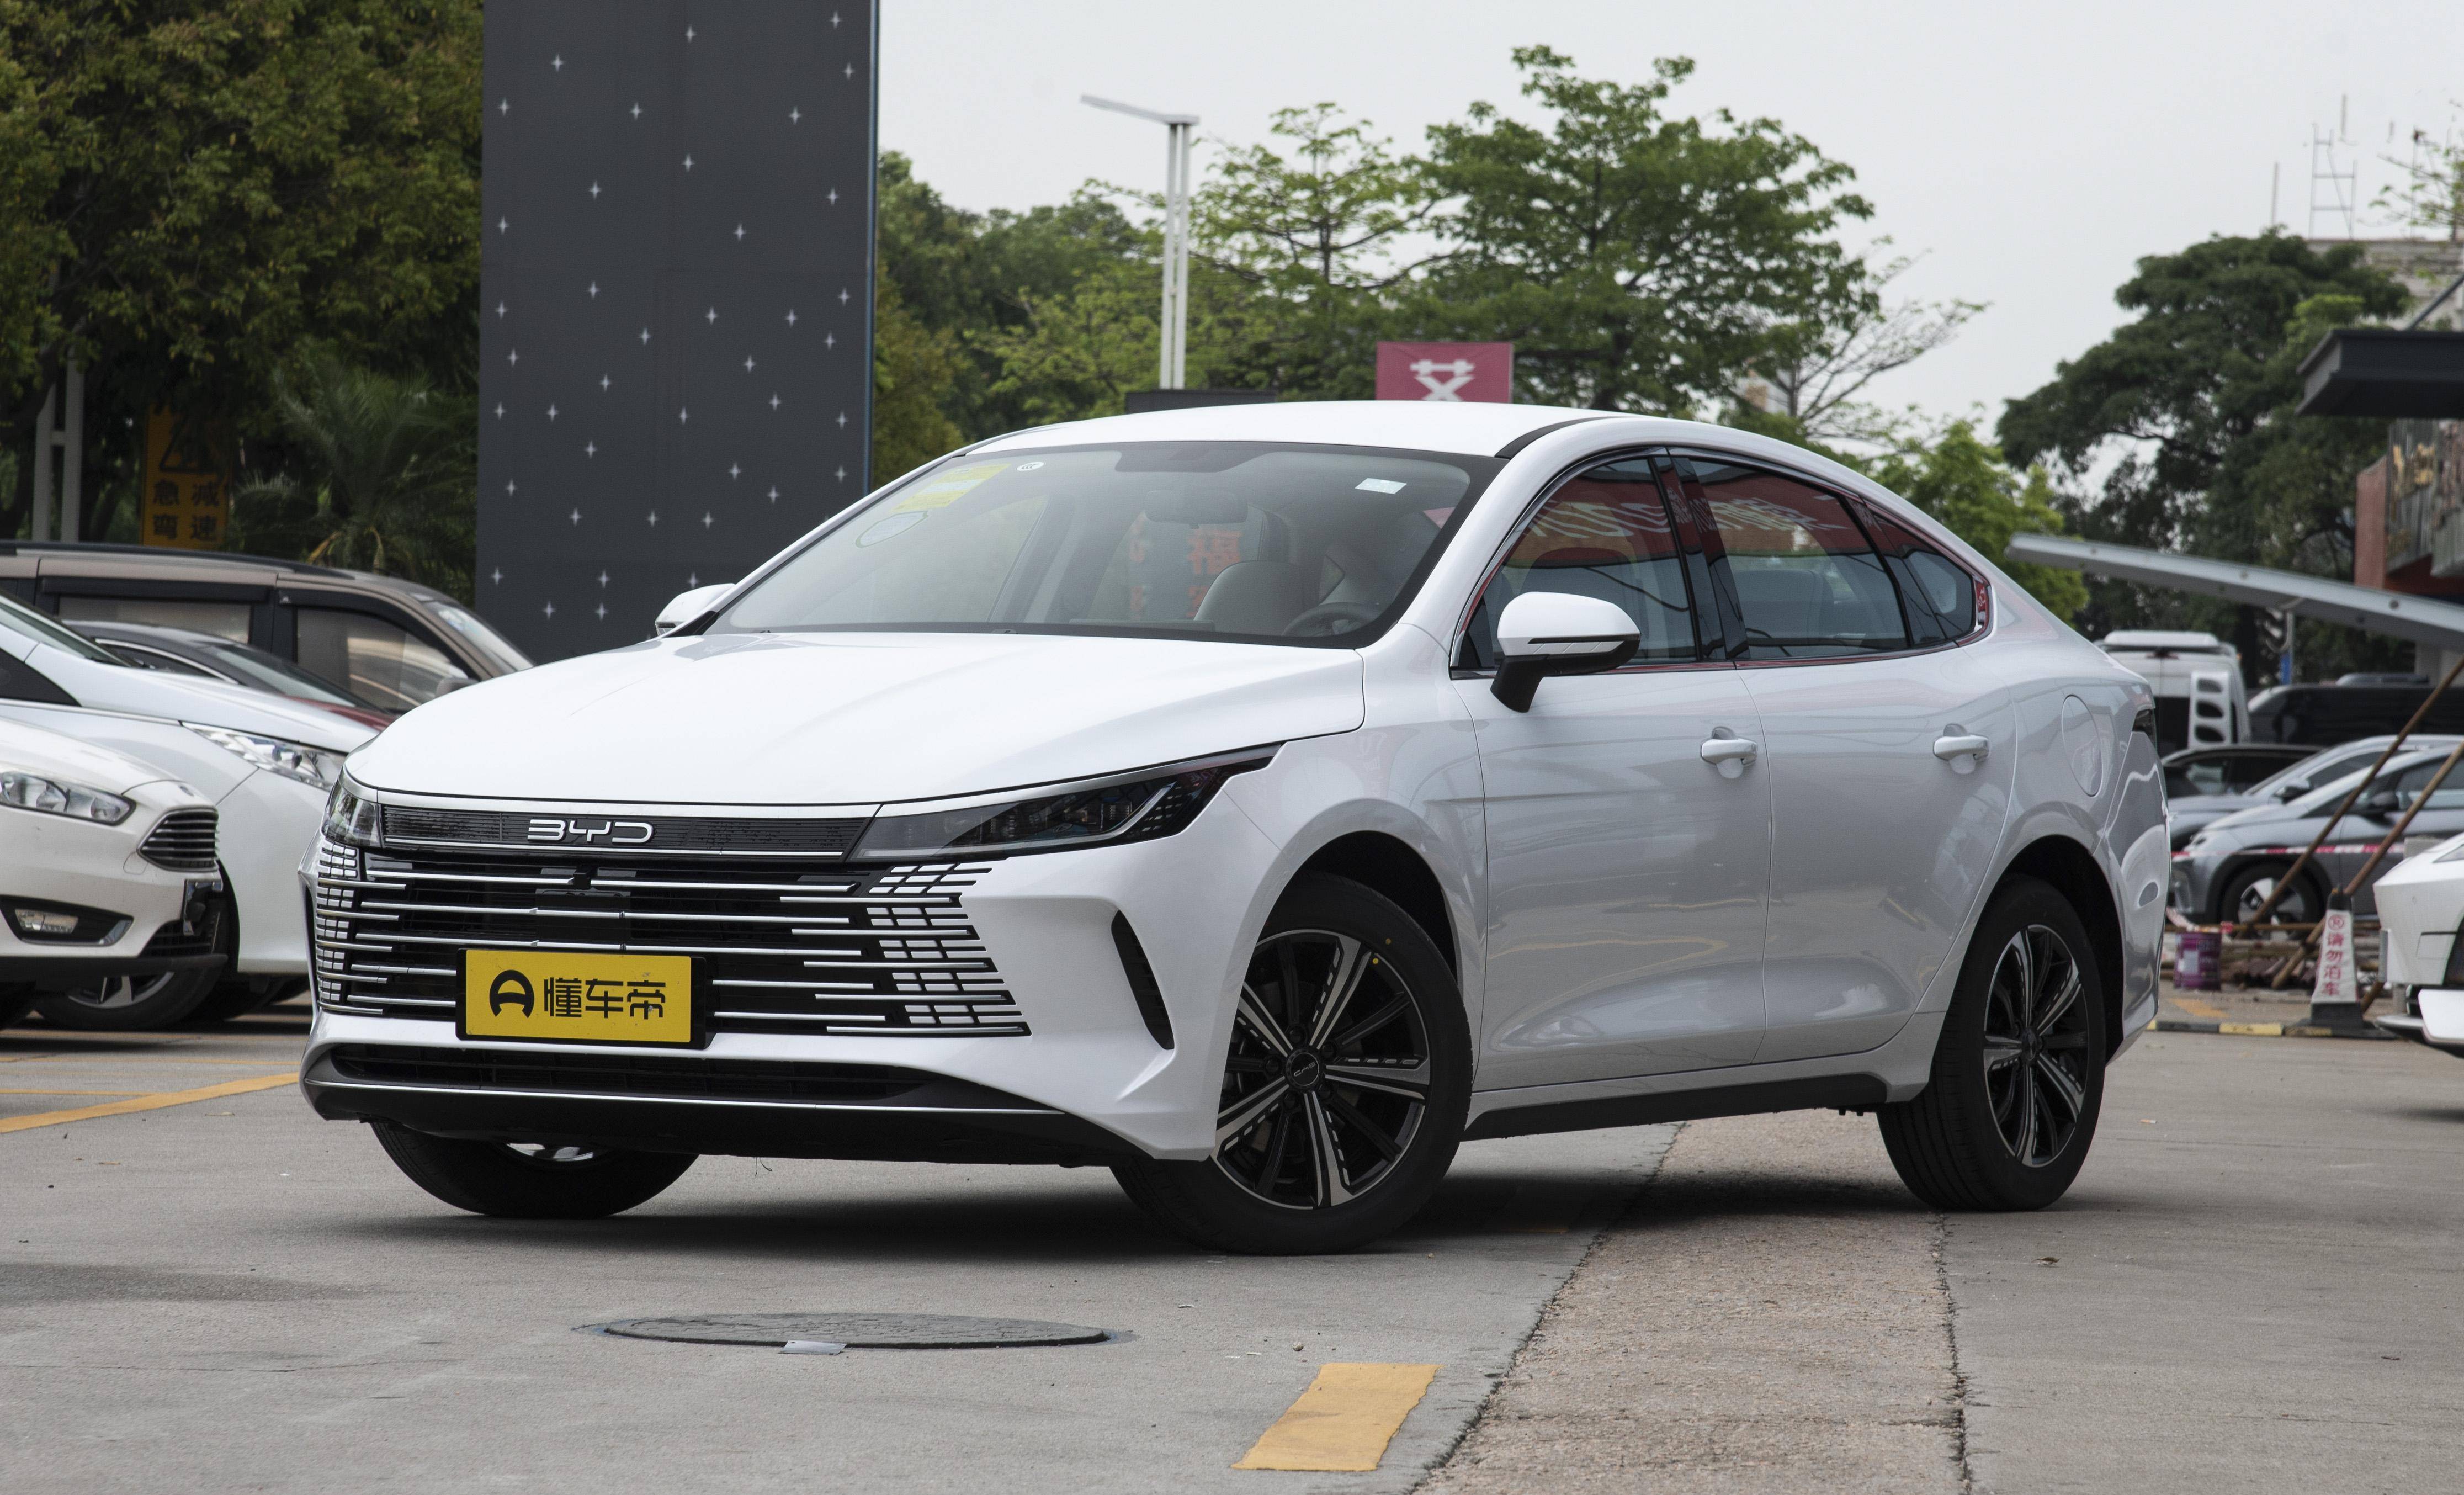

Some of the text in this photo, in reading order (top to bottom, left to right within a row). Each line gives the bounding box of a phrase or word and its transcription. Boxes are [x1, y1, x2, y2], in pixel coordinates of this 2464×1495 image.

[527, 818, 654, 844] BYD
[2322, 932, 2344, 996] 请勿泊车
[544, 976, 666, 1020] 懂车帝
